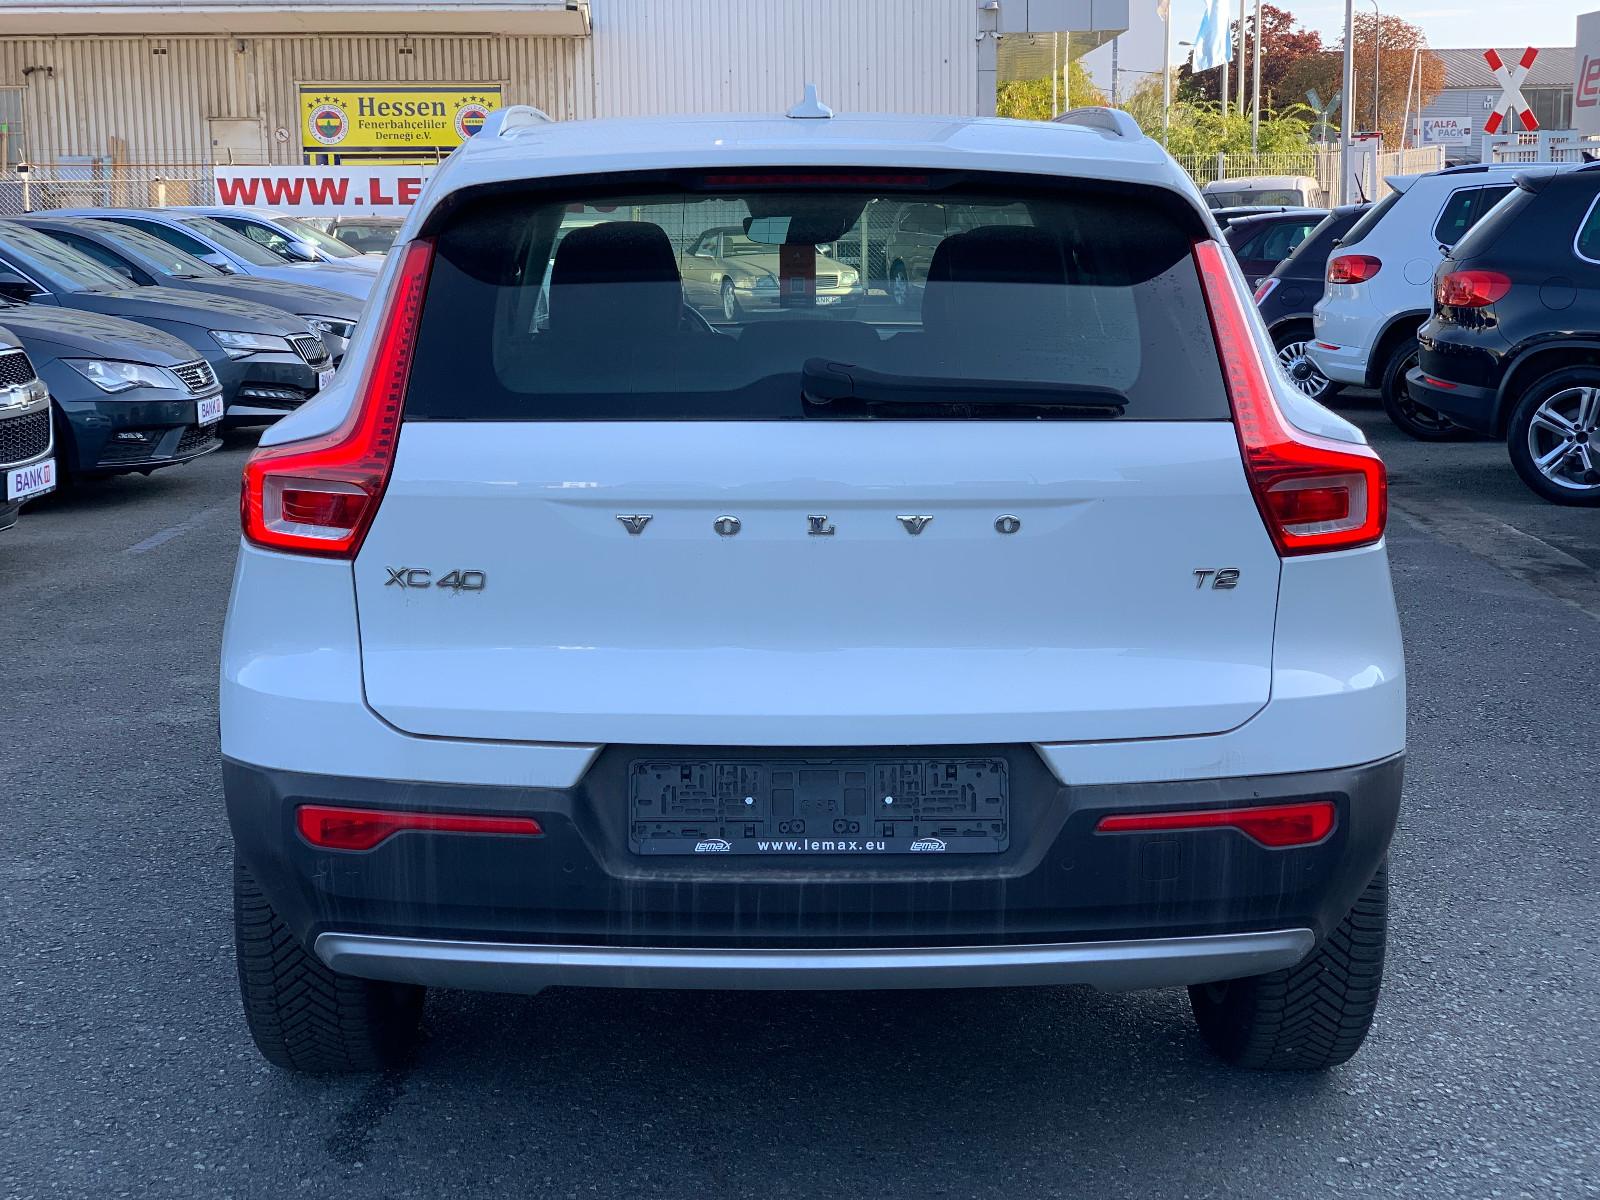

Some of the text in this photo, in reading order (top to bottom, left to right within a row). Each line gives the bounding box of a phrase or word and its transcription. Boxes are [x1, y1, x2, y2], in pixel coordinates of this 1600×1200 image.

[358, 97, 446, 117] Hessen
[358, 119, 447, 130] Fenerbahçeliler
[1434, 120, 1457, 128] ALFA
[416, 131, 432, 140] e.V.
[1438, 128, 1463, 137] PACK
[216, 177, 428, 206] WWW.LE
[16, 467, 43, 493] BANK
[616, 513, 1022, 536] VOLVO
[1193, 567, 1240, 590] T2
[757, 838, 886, 851] www.lemax.eu
